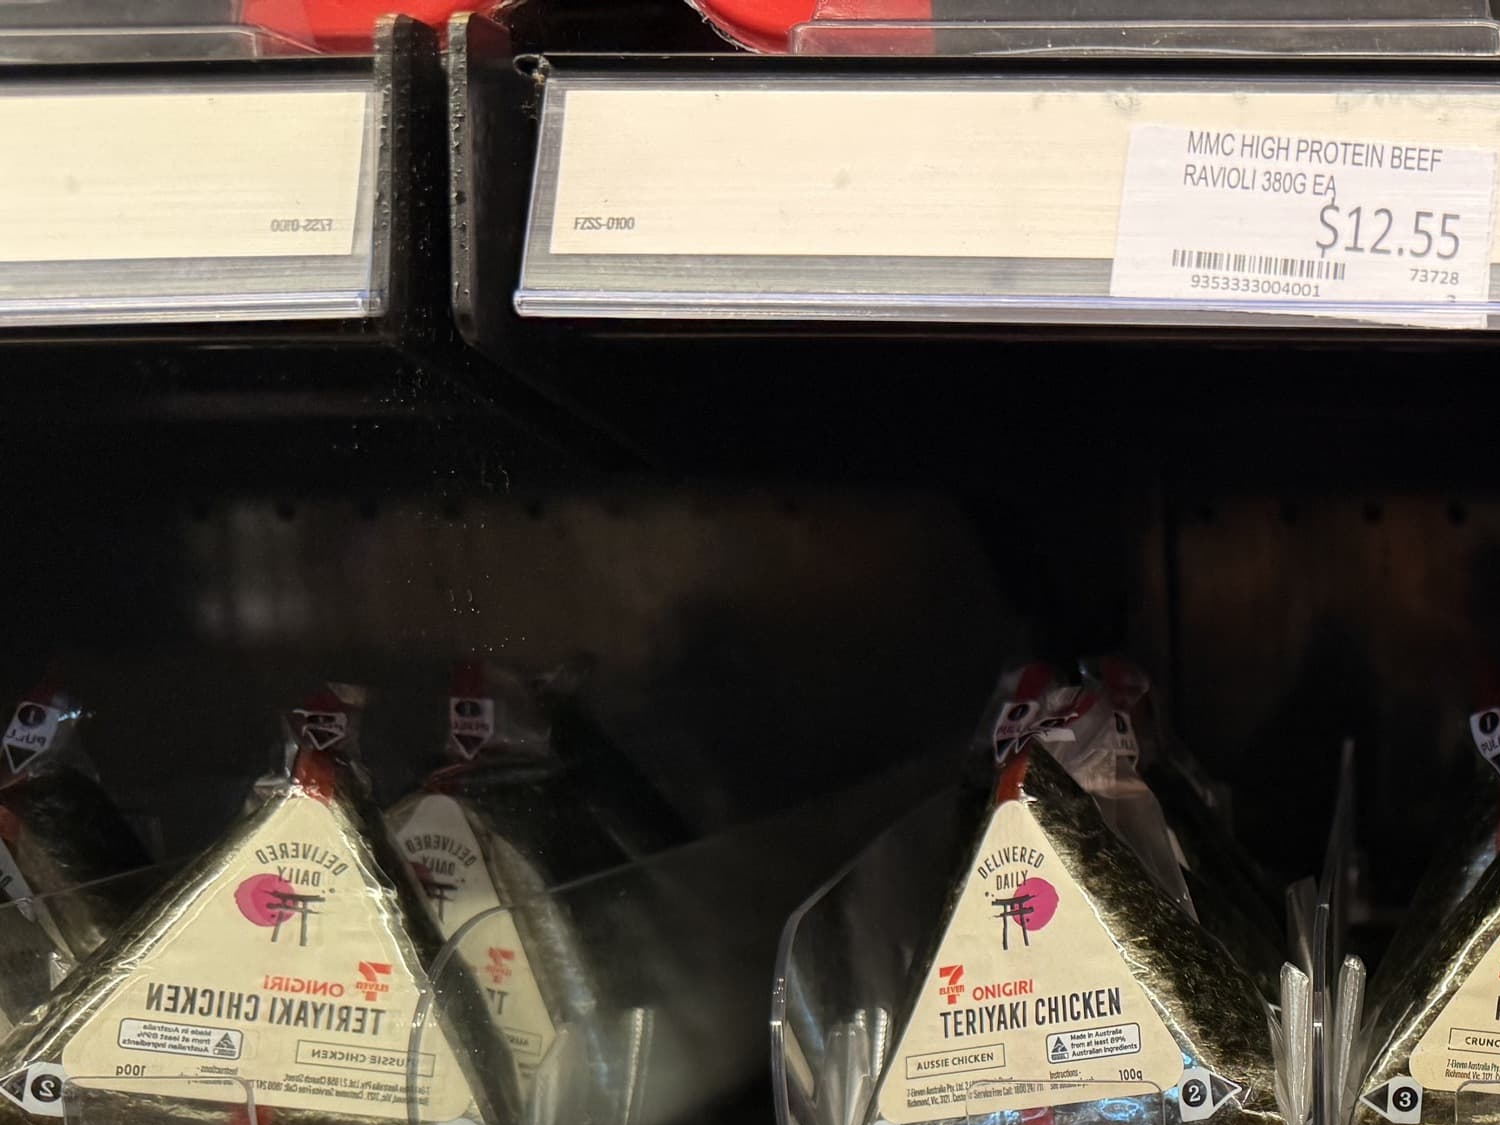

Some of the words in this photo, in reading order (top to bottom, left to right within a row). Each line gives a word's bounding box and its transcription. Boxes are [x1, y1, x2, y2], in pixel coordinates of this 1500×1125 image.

[1187, 131, 1235, 156] MMC
[1241, 134, 1289, 161] HIGH
[1296, 139, 1385, 169] PROTEIN
[1390, 146, 1443, 173] BEEF
[1183, 164, 1256, 191] RAVIOLI
[1261, 170, 1306, 194] 380G
[1312, 175, 1337, 197] EA
[573, 216, 635, 231] FZSS-0100
[1315, 196, 1461, 261] $12.55
[1190, 274, 1321, 298] 9353333004001
[1409, 268, 1460, 286] 73728
[977, 846, 1045, 879] DELIVERED
[996, 870, 1028, 891] DAILY
[939, 984, 965, 996] ELEVEN
[972, 979, 1034, 1001] ONIGIRI
[940, 1000, 1027, 1039] TERIYAKI
[1034, 987, 1122, 1026] CHICKEN
[1070, 1032, 1088, 1041] Made
[1095, 1028, 1123, 1038] Australia
[1071, 1041, 1086, 1050] from
[1094, 1038, 1109, 1047] least
[916, 1058, 950, 1071] AUSSIE
[951, 1052, 994, 1067] CHICKEN
[1072, 1047, 1102, 1058] Australian
